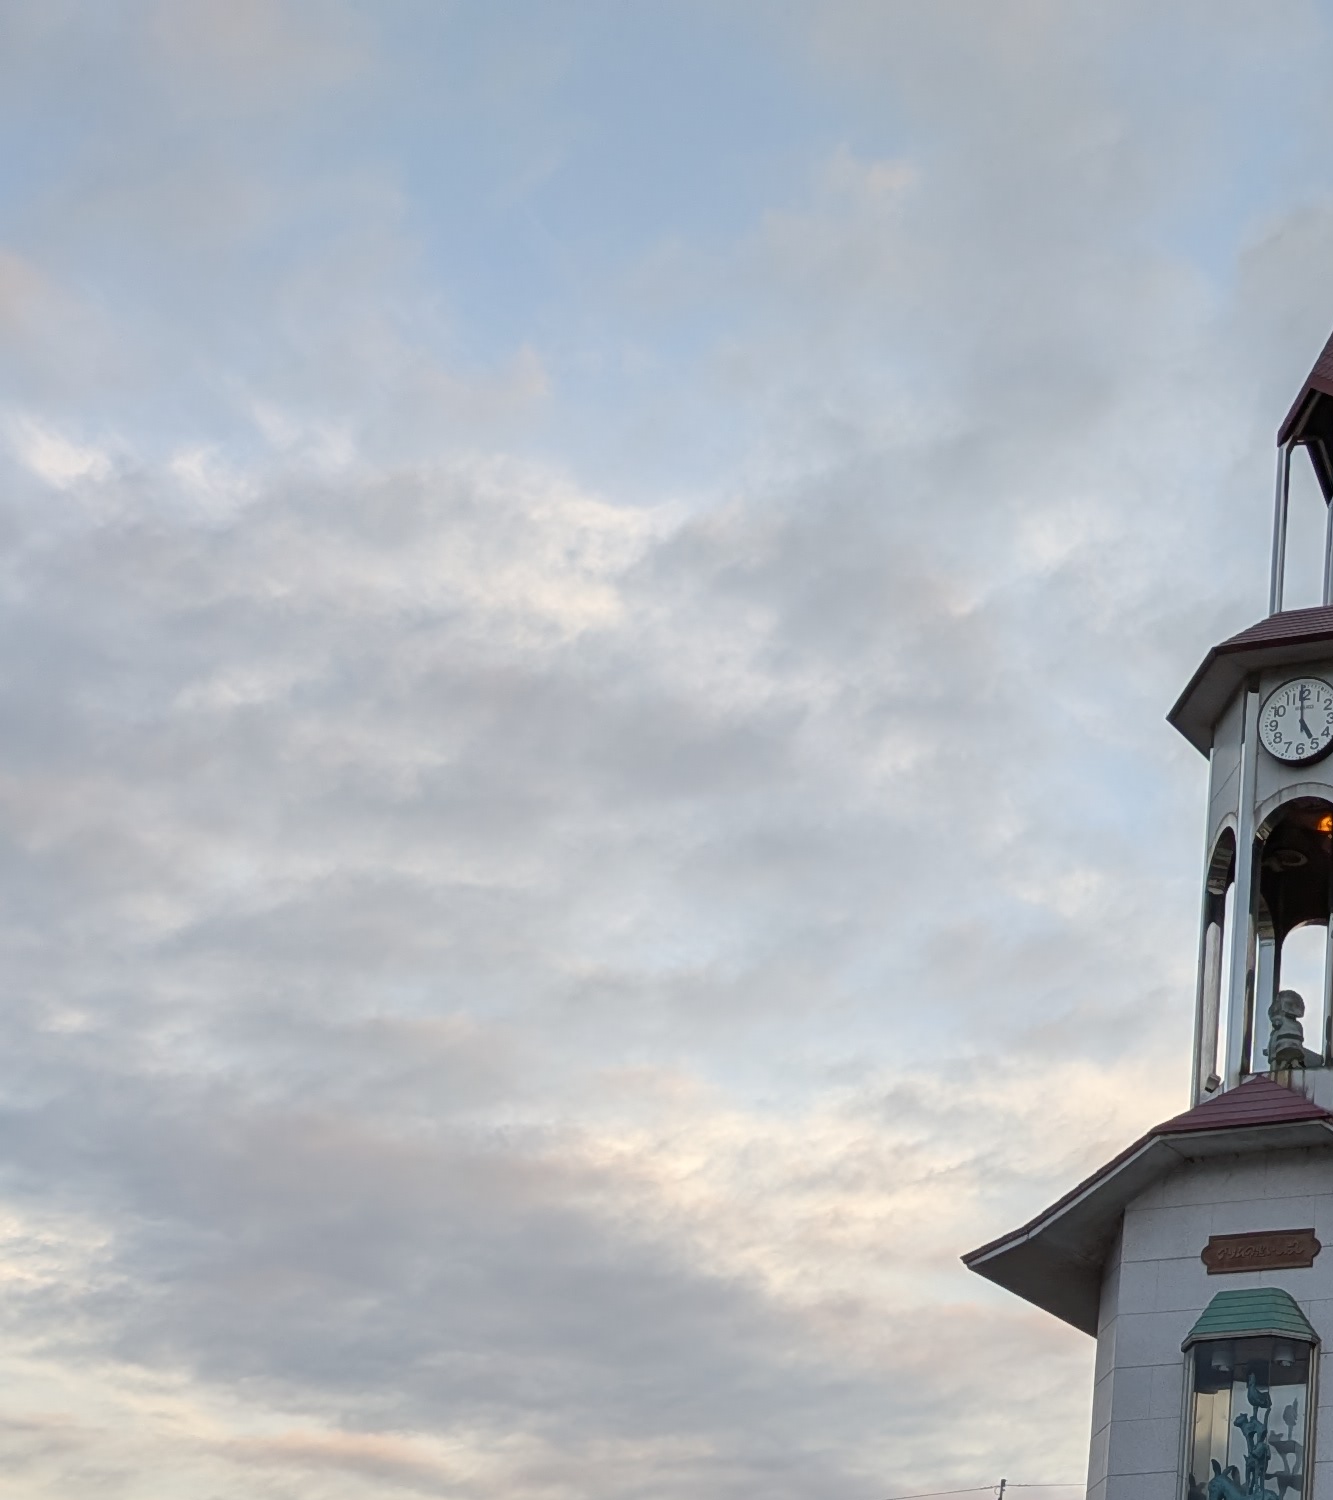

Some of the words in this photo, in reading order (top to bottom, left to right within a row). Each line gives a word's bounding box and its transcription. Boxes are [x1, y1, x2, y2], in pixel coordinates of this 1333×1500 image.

[1286, 693, 1296, 706] 11
[1323, 699, 1333, 710] 2
[1274, 705, 1286, 718] 10
[1269, 720, 1279, 732] 9
[1321, 726, 1330, 737] 4
[1273, 732, 1282, 744] 8
[1310, 738, 1319, 750] 5
[1284, 741, 1292, 753] 7
[1296, 743, 1305, 755] 6
